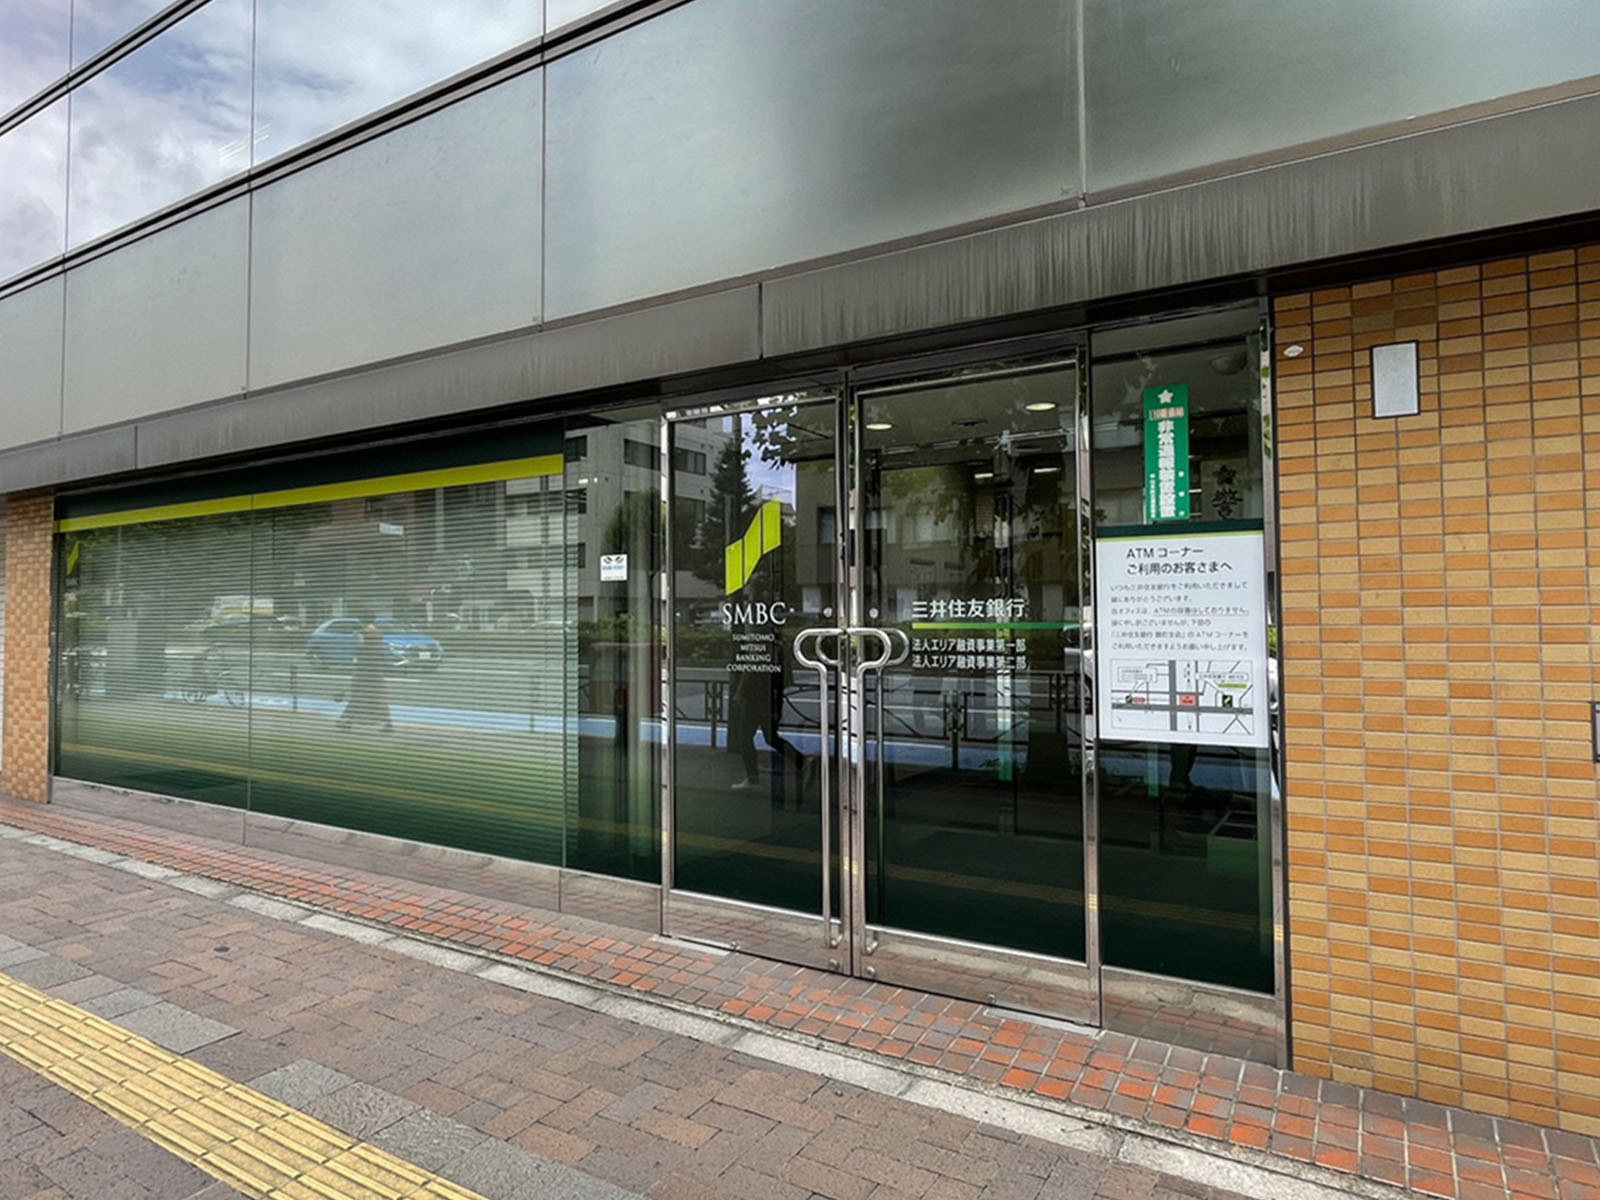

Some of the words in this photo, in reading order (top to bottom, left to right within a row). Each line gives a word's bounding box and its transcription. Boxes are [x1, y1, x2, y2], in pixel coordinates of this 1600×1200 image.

[1126, 561, 1233, 576] ご利用のお客さまへ
[722, 602, 786, 625] SMBC
[911, 598, 1025, 618] 三井住友銀行
[732, 633, 775, 642] SUMITOMO
[736, 653, 772, 662] BANKING
[726, 663, 782, 673] CORPORATION
